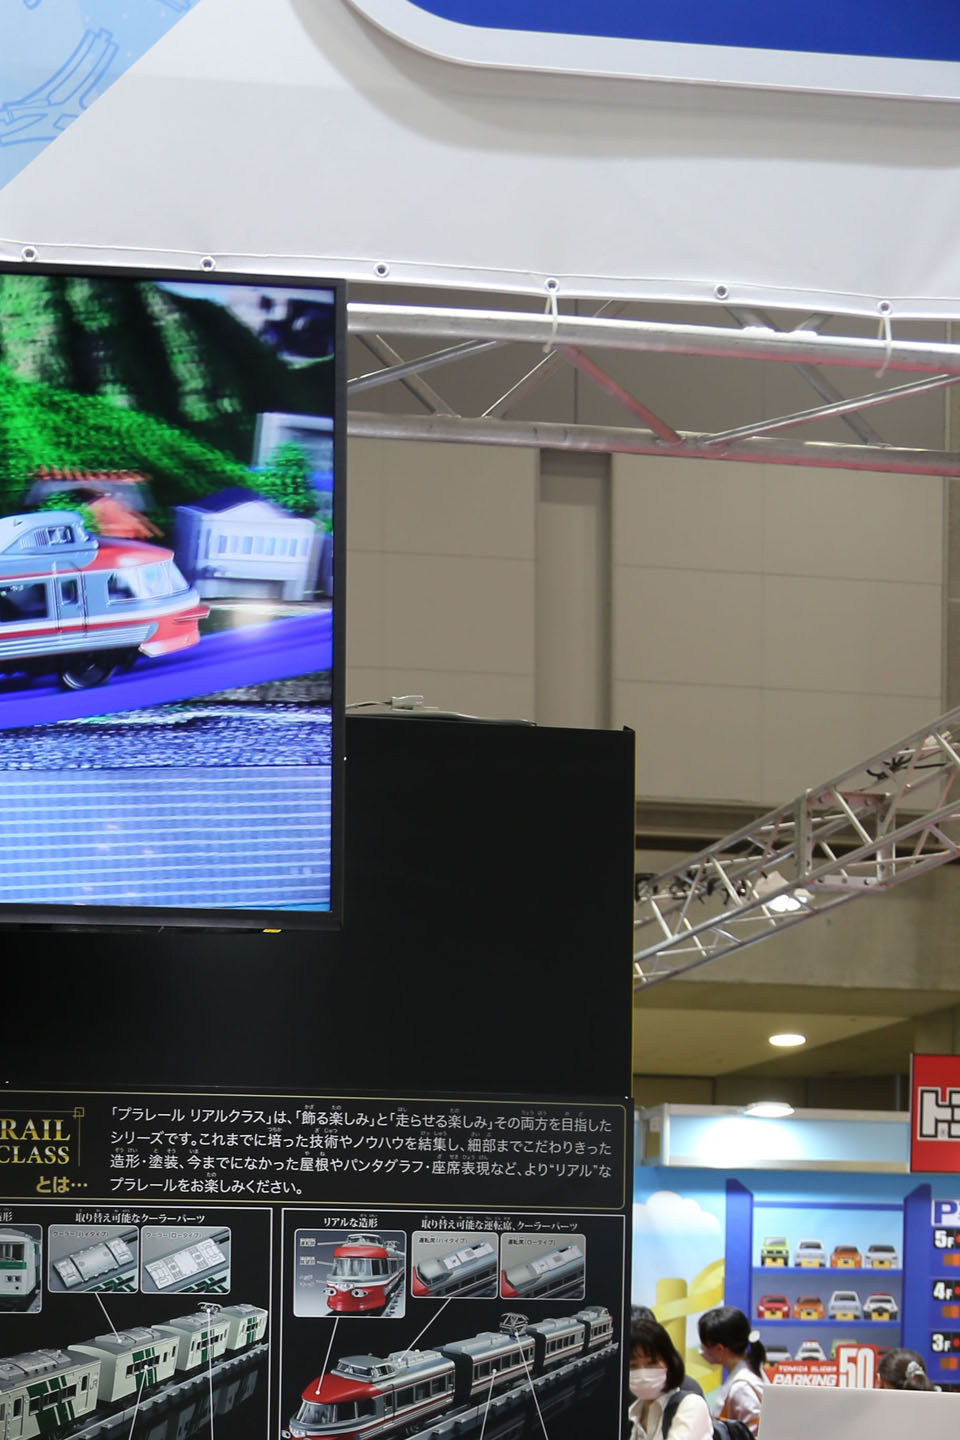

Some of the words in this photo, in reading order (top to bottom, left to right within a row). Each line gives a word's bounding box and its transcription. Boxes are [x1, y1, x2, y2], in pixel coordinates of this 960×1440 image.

[110, 1176, 302, 1195] プラレールをお楽しみください。
[75, 1212, 206, 1224] 取り替え可能なクーラーパーツ
[323, 1216, 379, 1228] リアルな造形
[934, 1230, 954, 1248] 5F
[933, 1282, 953, 1300] 4F
[932, 1333, 951, 1351] 3F
[839, 1347, 875, 1388] 50
[772, 1374, 837, 1386] PARKING
